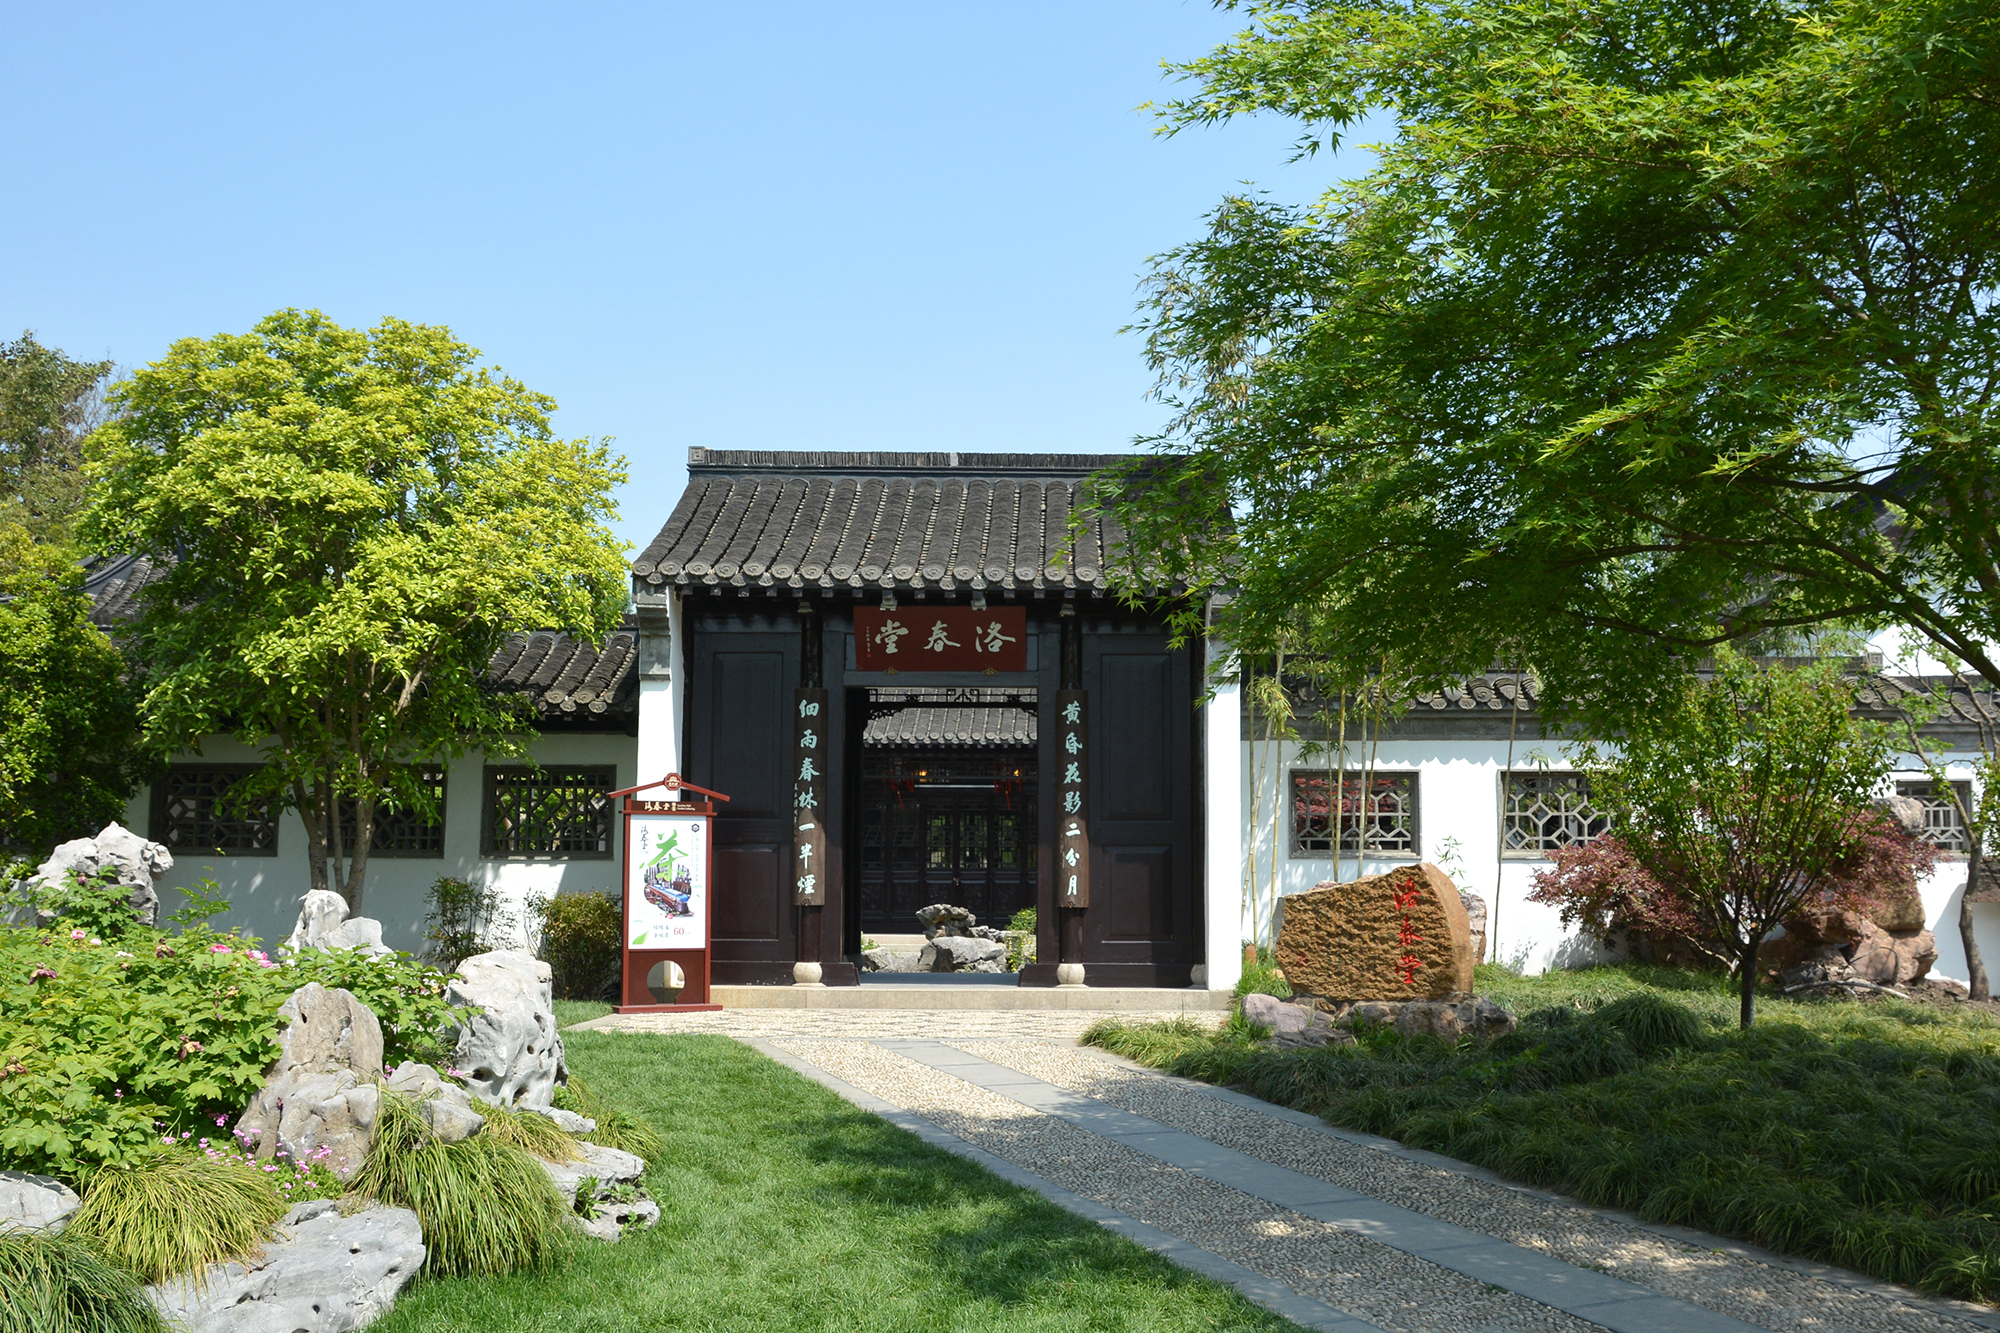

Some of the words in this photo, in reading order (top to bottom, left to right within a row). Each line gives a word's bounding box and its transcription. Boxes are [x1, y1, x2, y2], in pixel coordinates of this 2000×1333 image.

[874, 619, 1016, 654] 洛春堂
[647, 829, 689, 882] 茶
[673, 927, 685, 936] 60
[1393, 876, 1423, 984] 洛春堂
